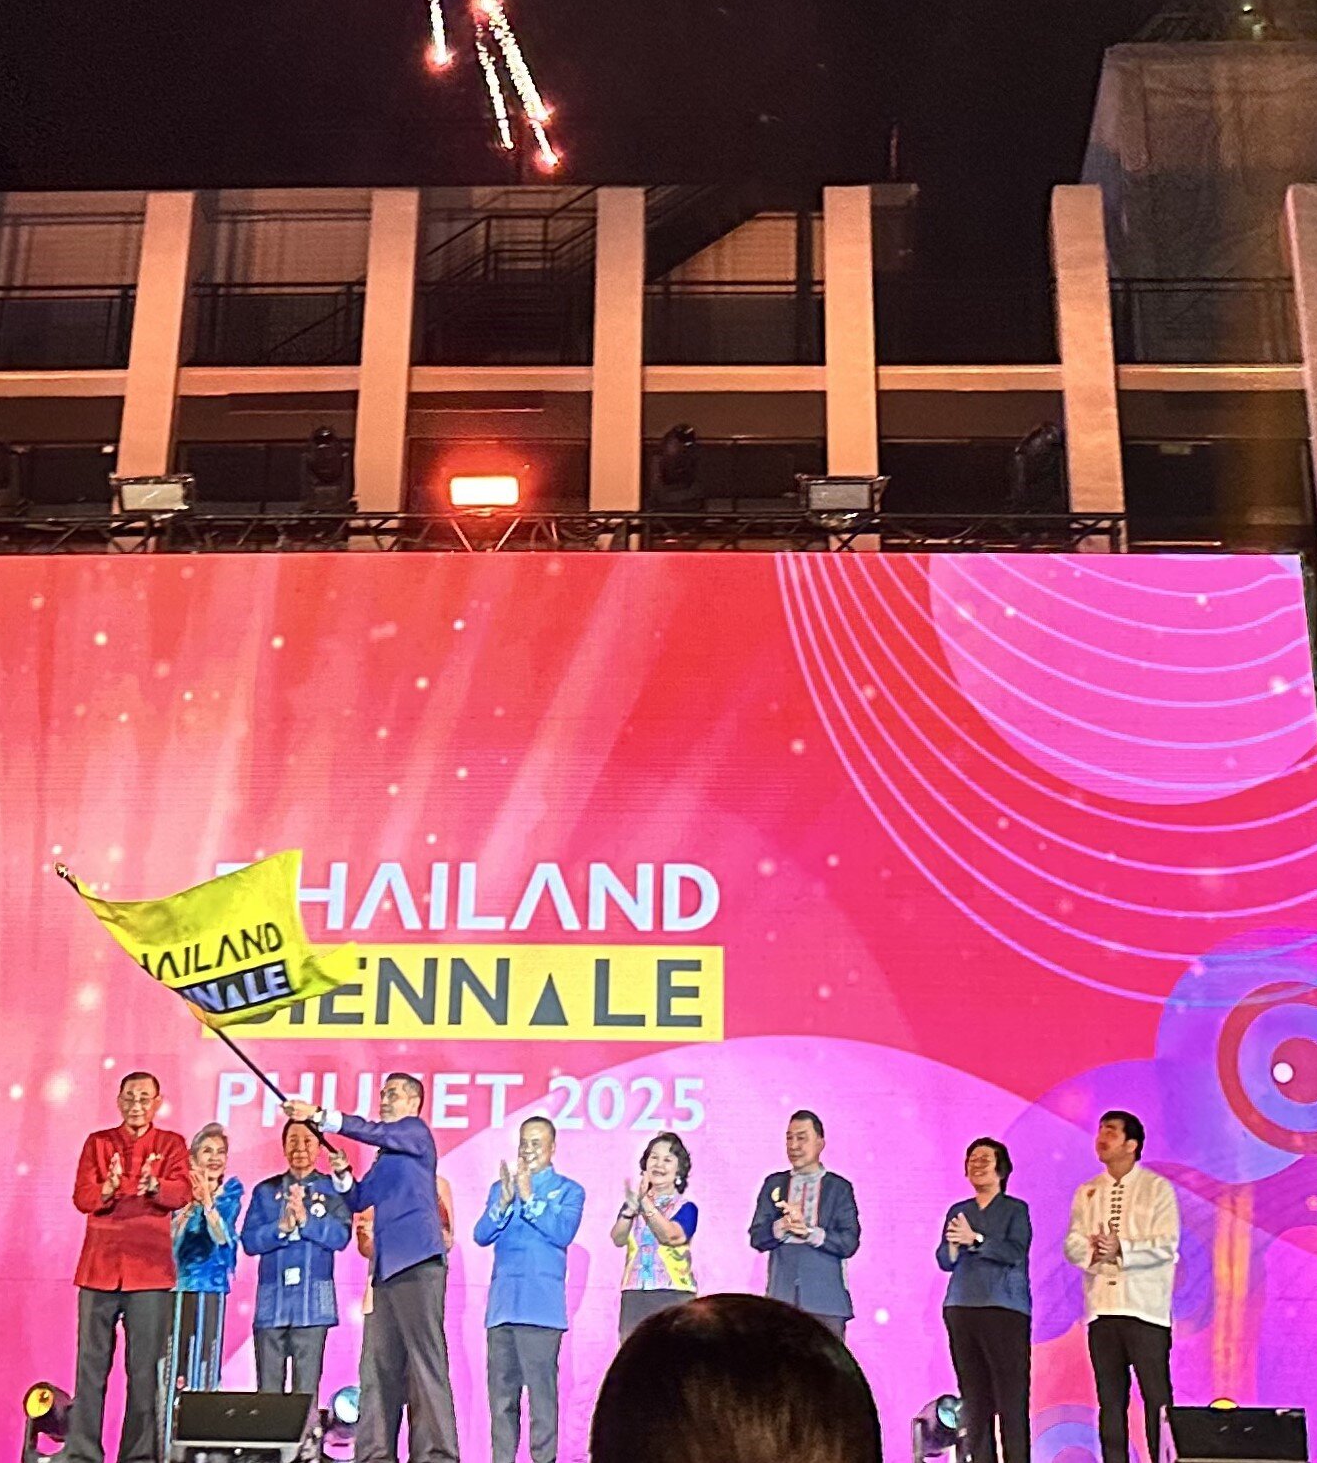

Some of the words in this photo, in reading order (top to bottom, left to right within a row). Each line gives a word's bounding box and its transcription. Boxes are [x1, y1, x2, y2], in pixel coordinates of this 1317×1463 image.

[215, 861, 720, 931] HAILAND
[242, 957, 702, 1027] ENNALE
[215, 1071, 524, 1129] PHUET
[548, 1075, 705, 1132] 2025
